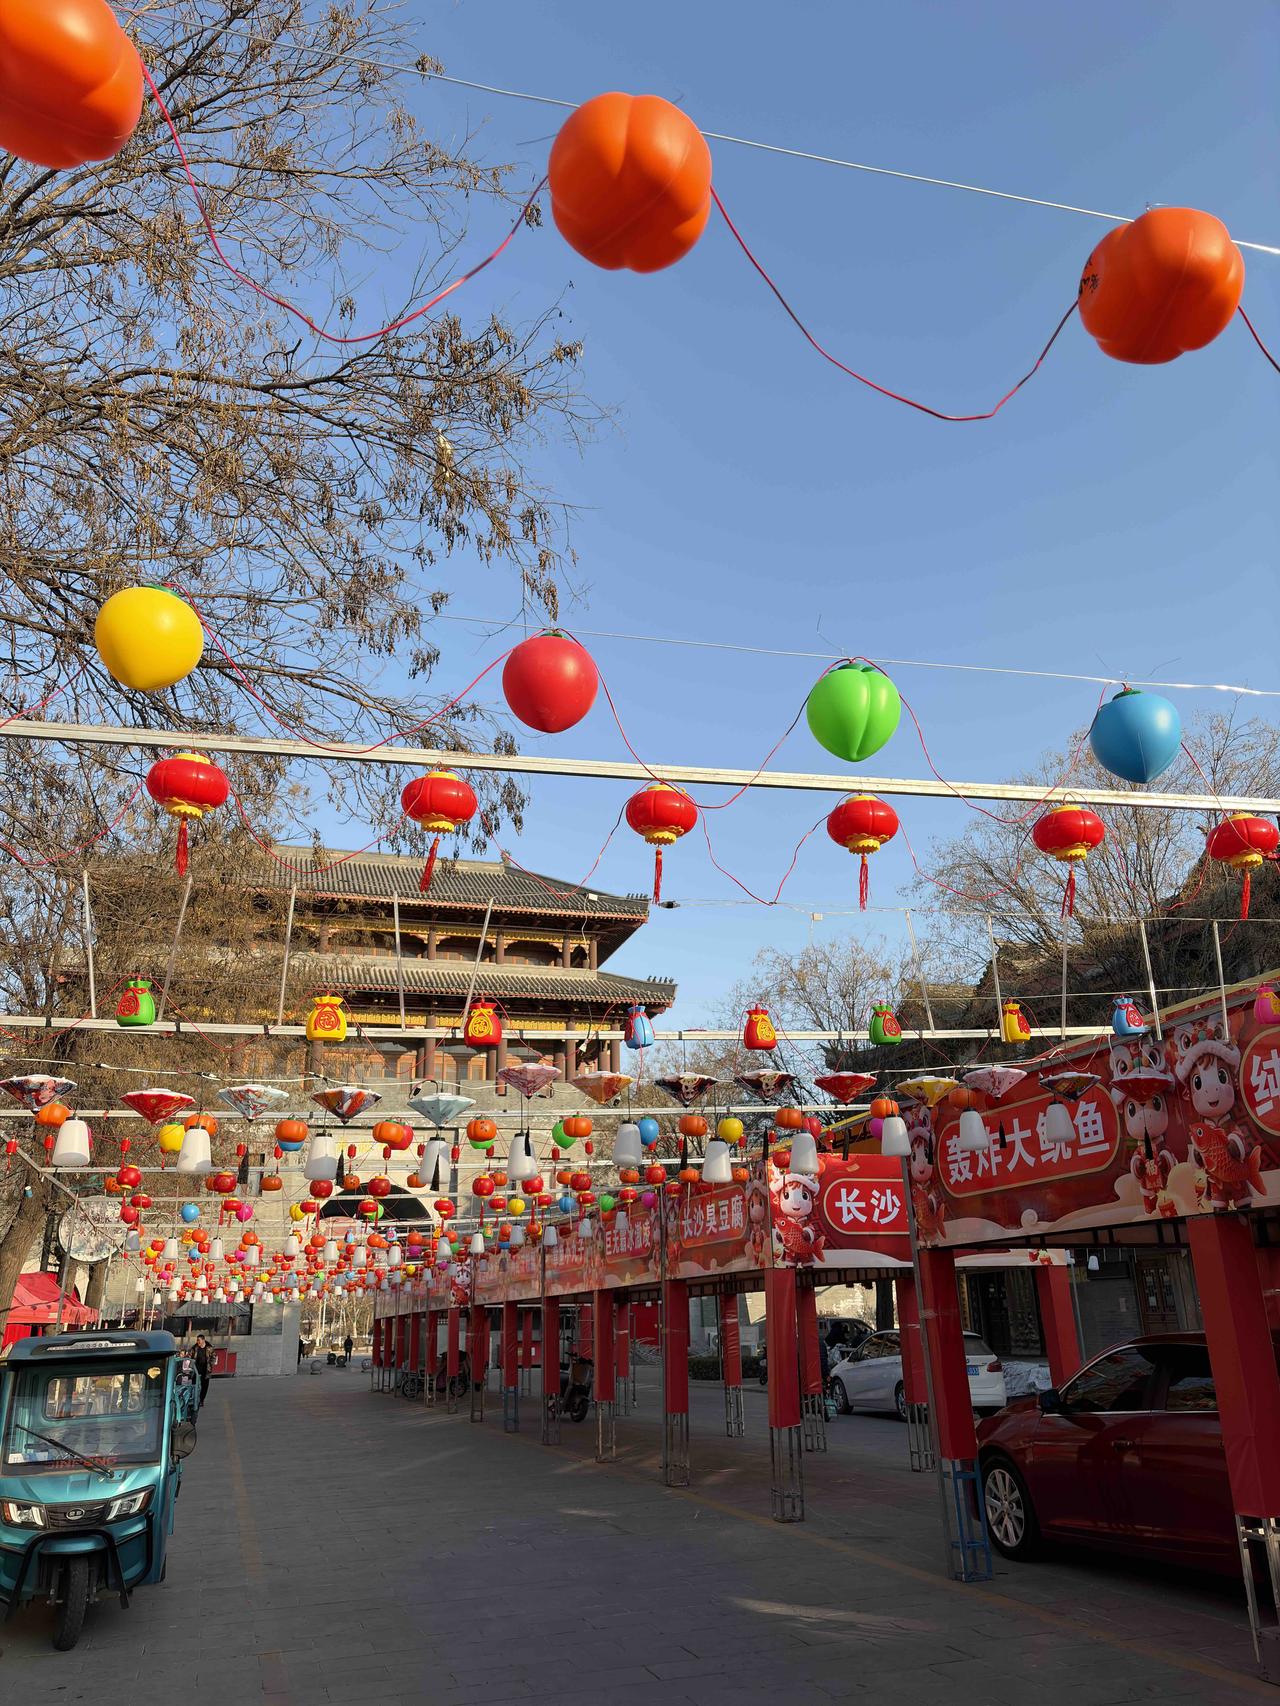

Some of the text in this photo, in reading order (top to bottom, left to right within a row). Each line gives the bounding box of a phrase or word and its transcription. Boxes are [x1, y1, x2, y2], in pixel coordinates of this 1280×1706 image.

[682, 1194, 744, 1240] 长沙臭豆腐
